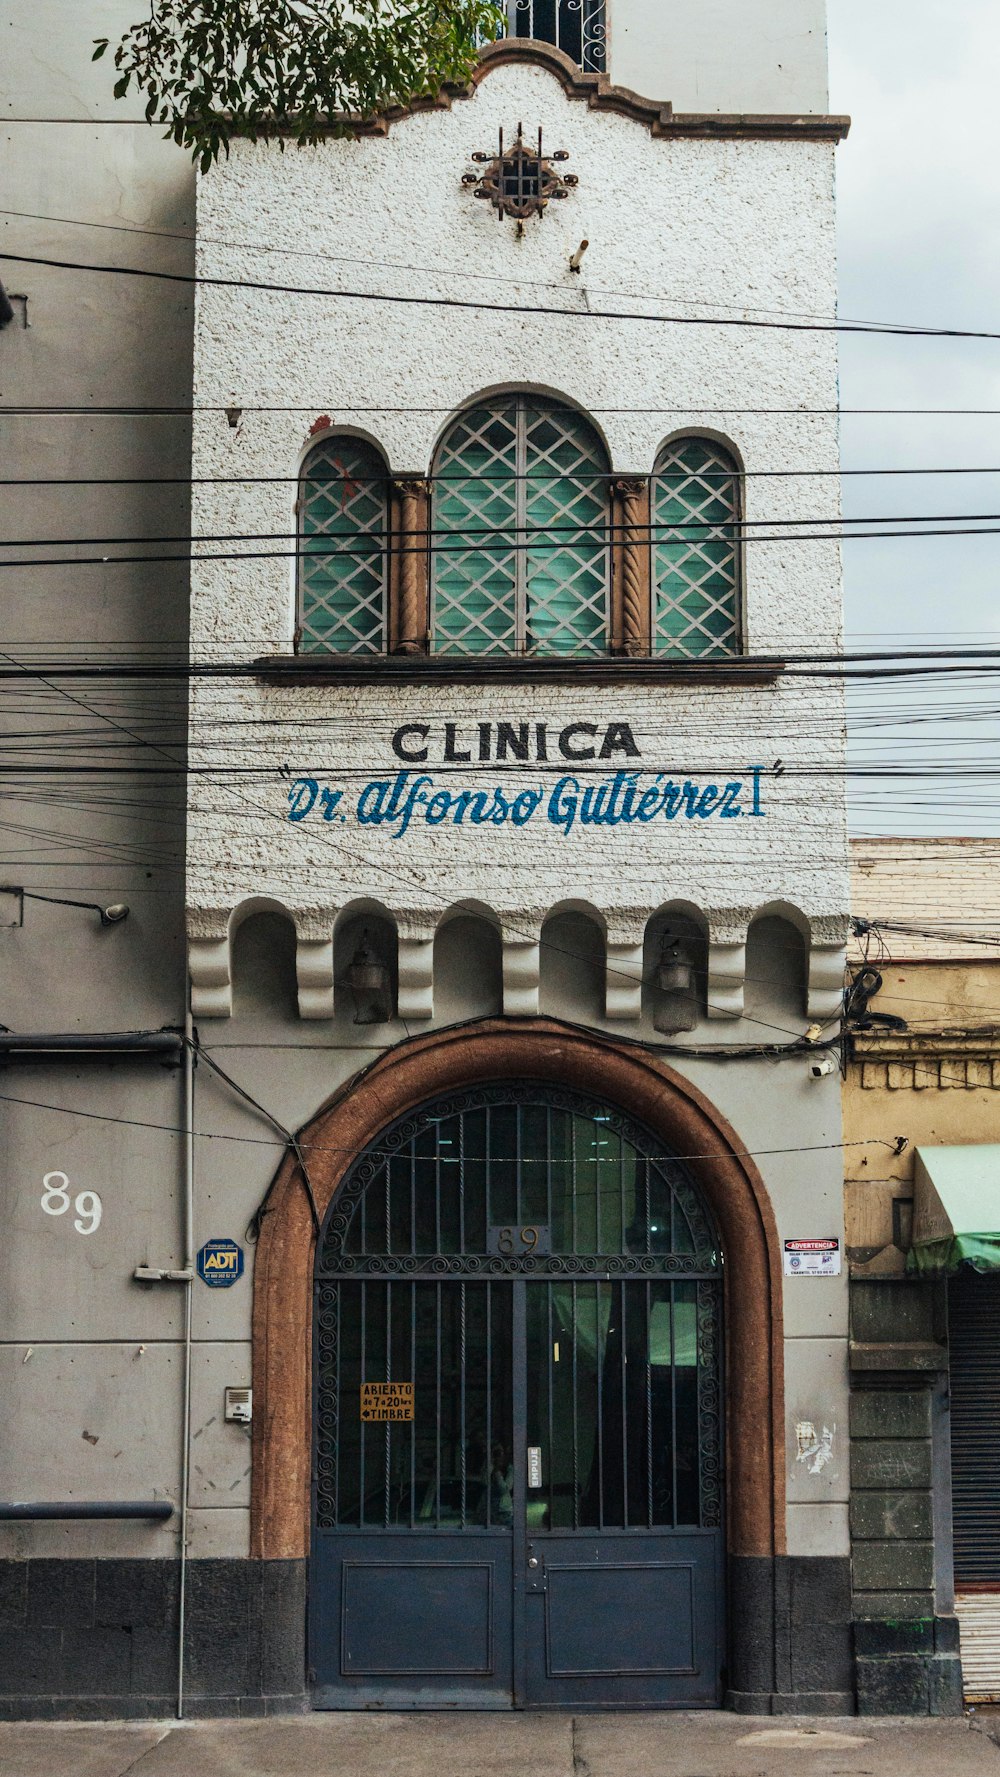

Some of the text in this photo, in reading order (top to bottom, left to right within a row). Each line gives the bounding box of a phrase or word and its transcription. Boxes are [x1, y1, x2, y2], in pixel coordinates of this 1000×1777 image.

[392, 722, 642, 762] CLINICA
[41, 1170, 103, 1235] 89
[498, 1226, 539, 1255] 89
[205, 1252, 238, 1269] ADT
[364, 1385, 412, 1395] ABIERTO
[363, 1398, 373, 1406] de
[374, 1397, 380, 1408] 7
[387, 1397, 400, 1407] 20
[370, 1409, 411, 1419] TIMBRE
[531, 1448, 539, 1486] EMPUJE
